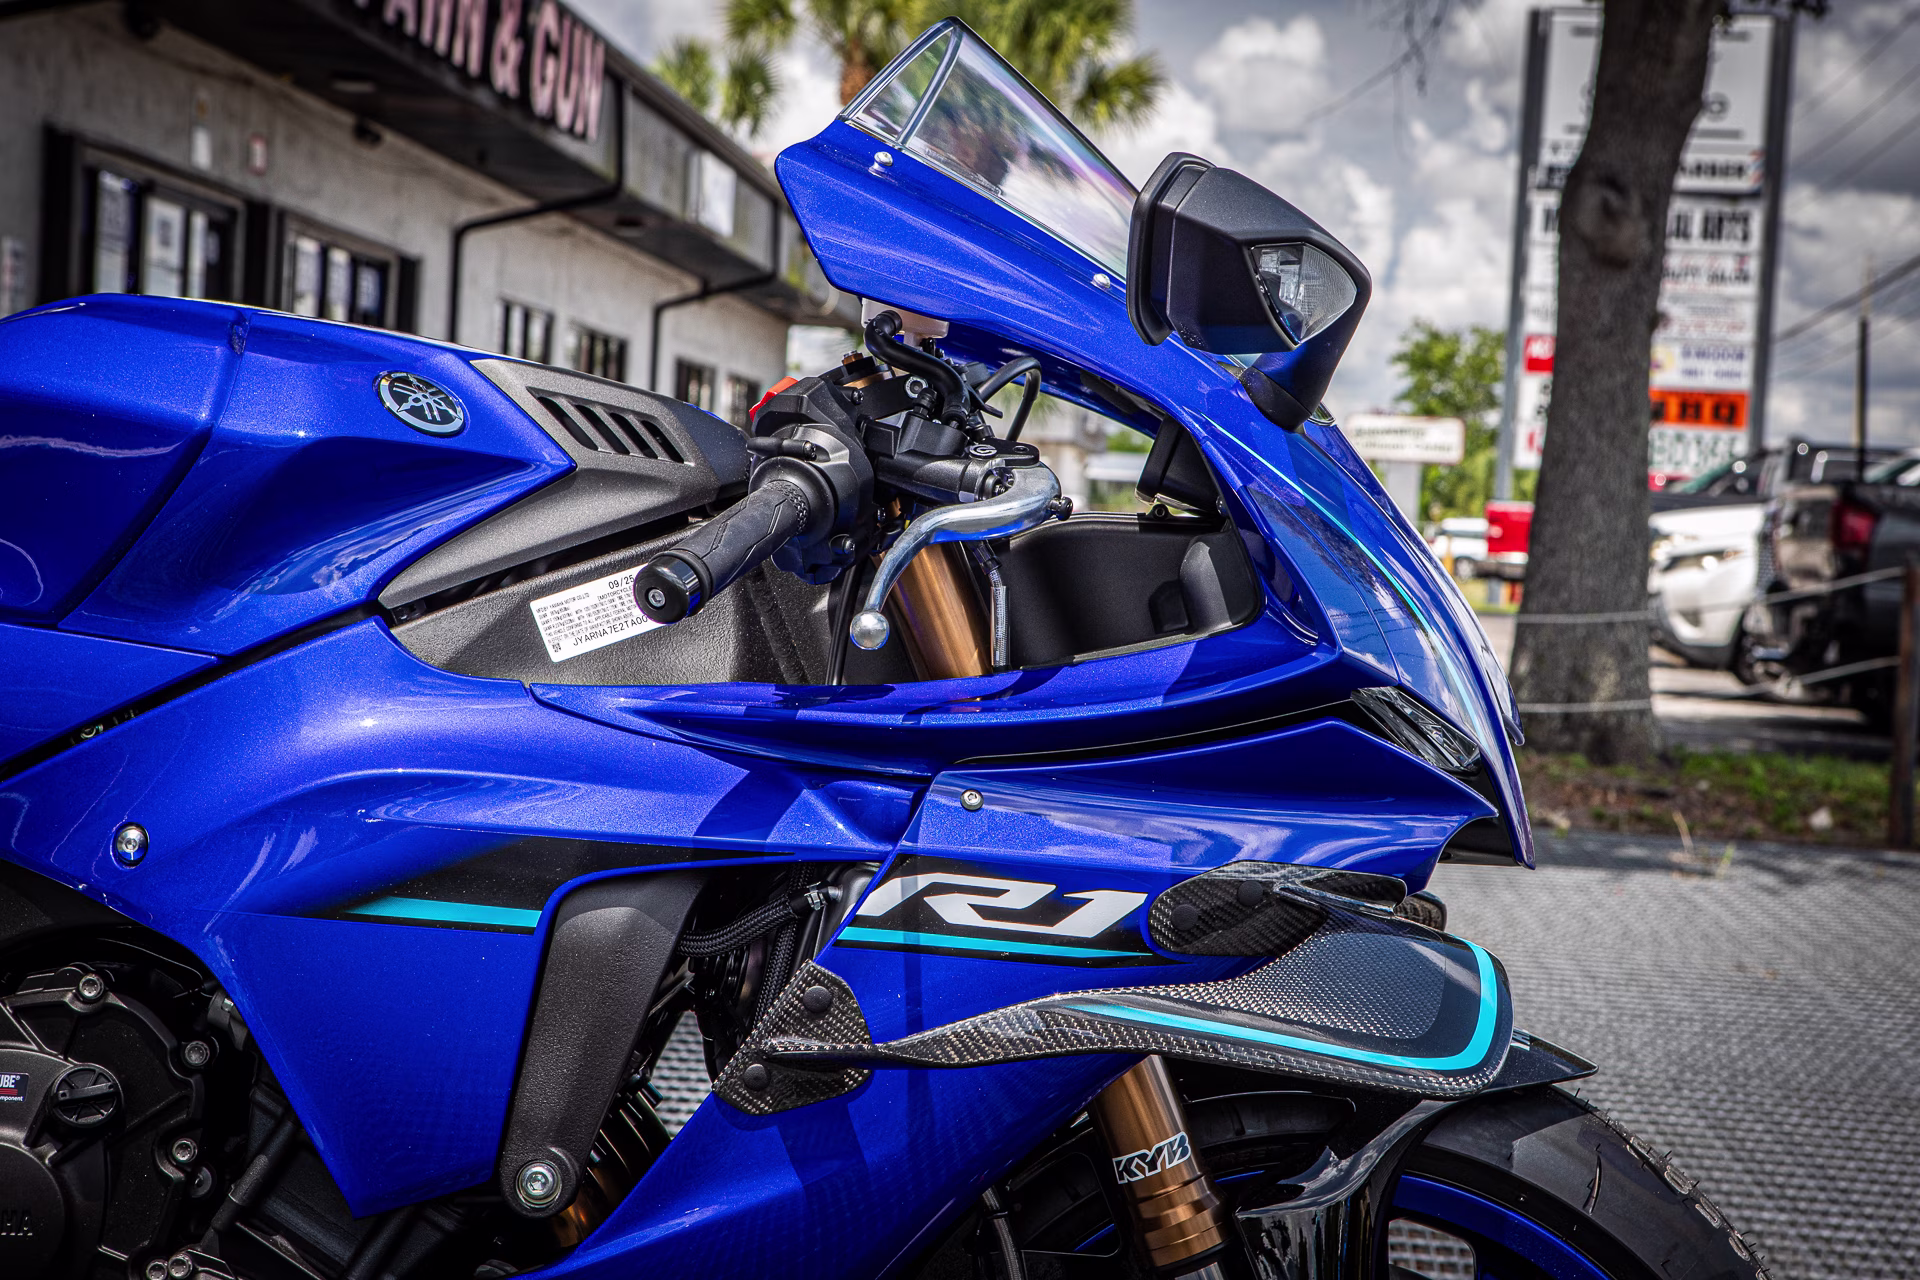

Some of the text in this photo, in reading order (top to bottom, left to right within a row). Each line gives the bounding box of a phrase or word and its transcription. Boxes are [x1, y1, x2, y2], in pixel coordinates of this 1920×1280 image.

[529, 0, 605, 142] GUN
[608, 575, 634, 589] 09/25
[842, 872, 1148, 939] R1
[1112, 1131, 1192, 1184] KYB
